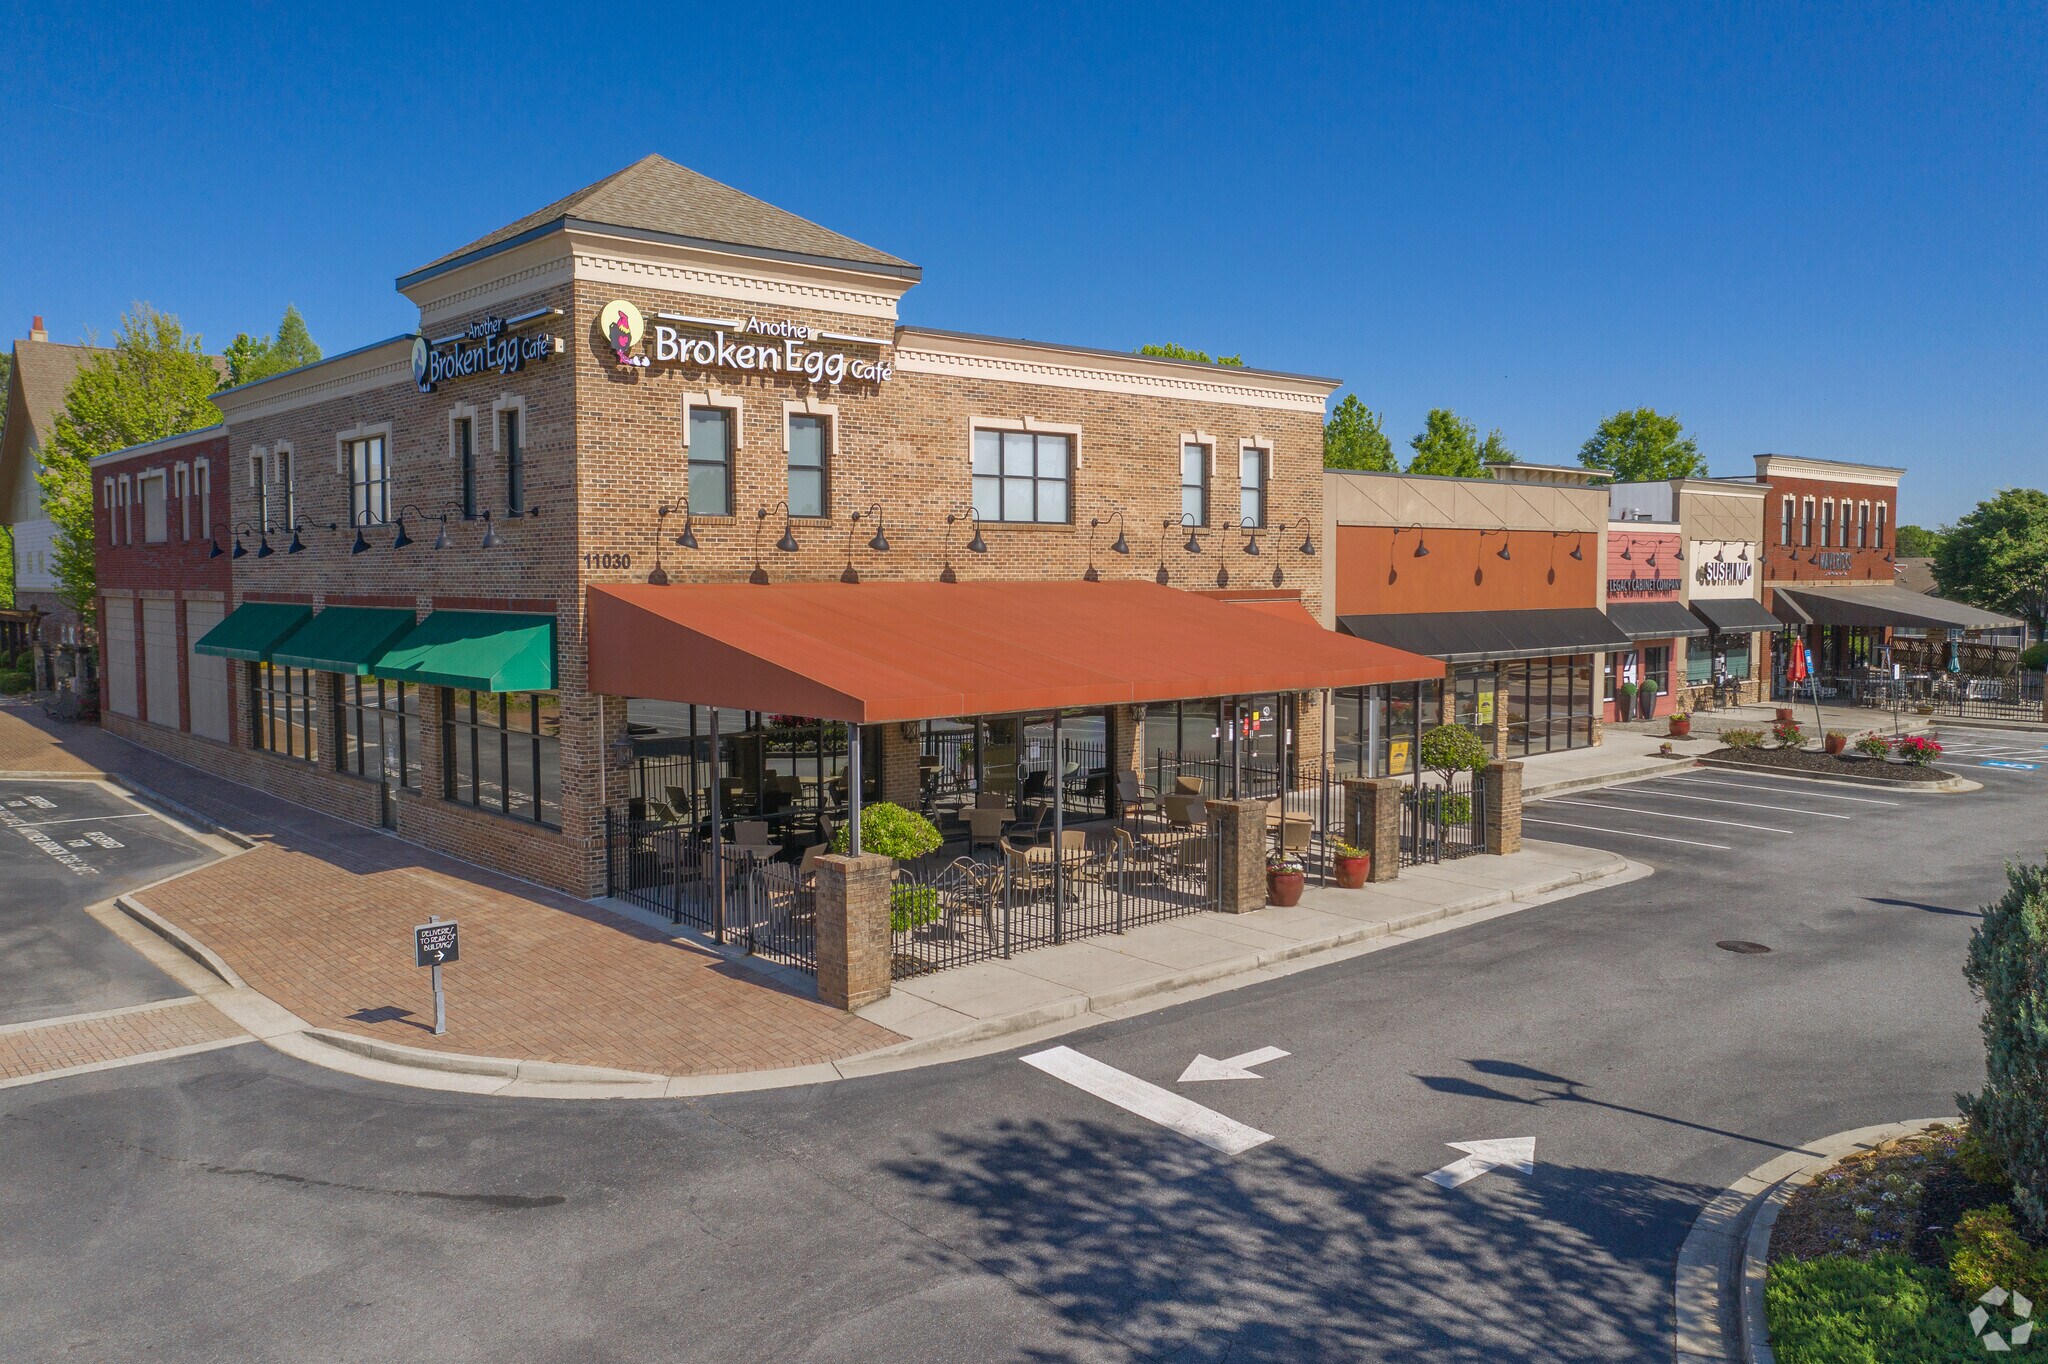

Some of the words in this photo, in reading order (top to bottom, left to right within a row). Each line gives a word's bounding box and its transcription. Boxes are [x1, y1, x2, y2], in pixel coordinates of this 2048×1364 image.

[468, 316, 502, 339] Another
[746, 316, 815, 339] Another
[430, 343, 484, 382] Broken
[486, 334, 519, 375] Egg
[522, 333, 548, 361] Café
[655, 326, 778, 373] Broken
[784, 340, 843, 384] Egg
[851, 360, 892, 384] Café
[584, 554, 631, 569] 11030
[1706, 562, 1734, 580] SUSHI
[1609, 579, 1631, 592] LEGACY
[1632, 579, 1656, 591] CABINET
[1656, 579, 1681, 591] COMPANY
[420, 937, 430, 945] TO
[430, 935, 447, 943] REAR
[447, 933, 456, 941] OF
[421, 927, 455, 938] DELIVERIES
